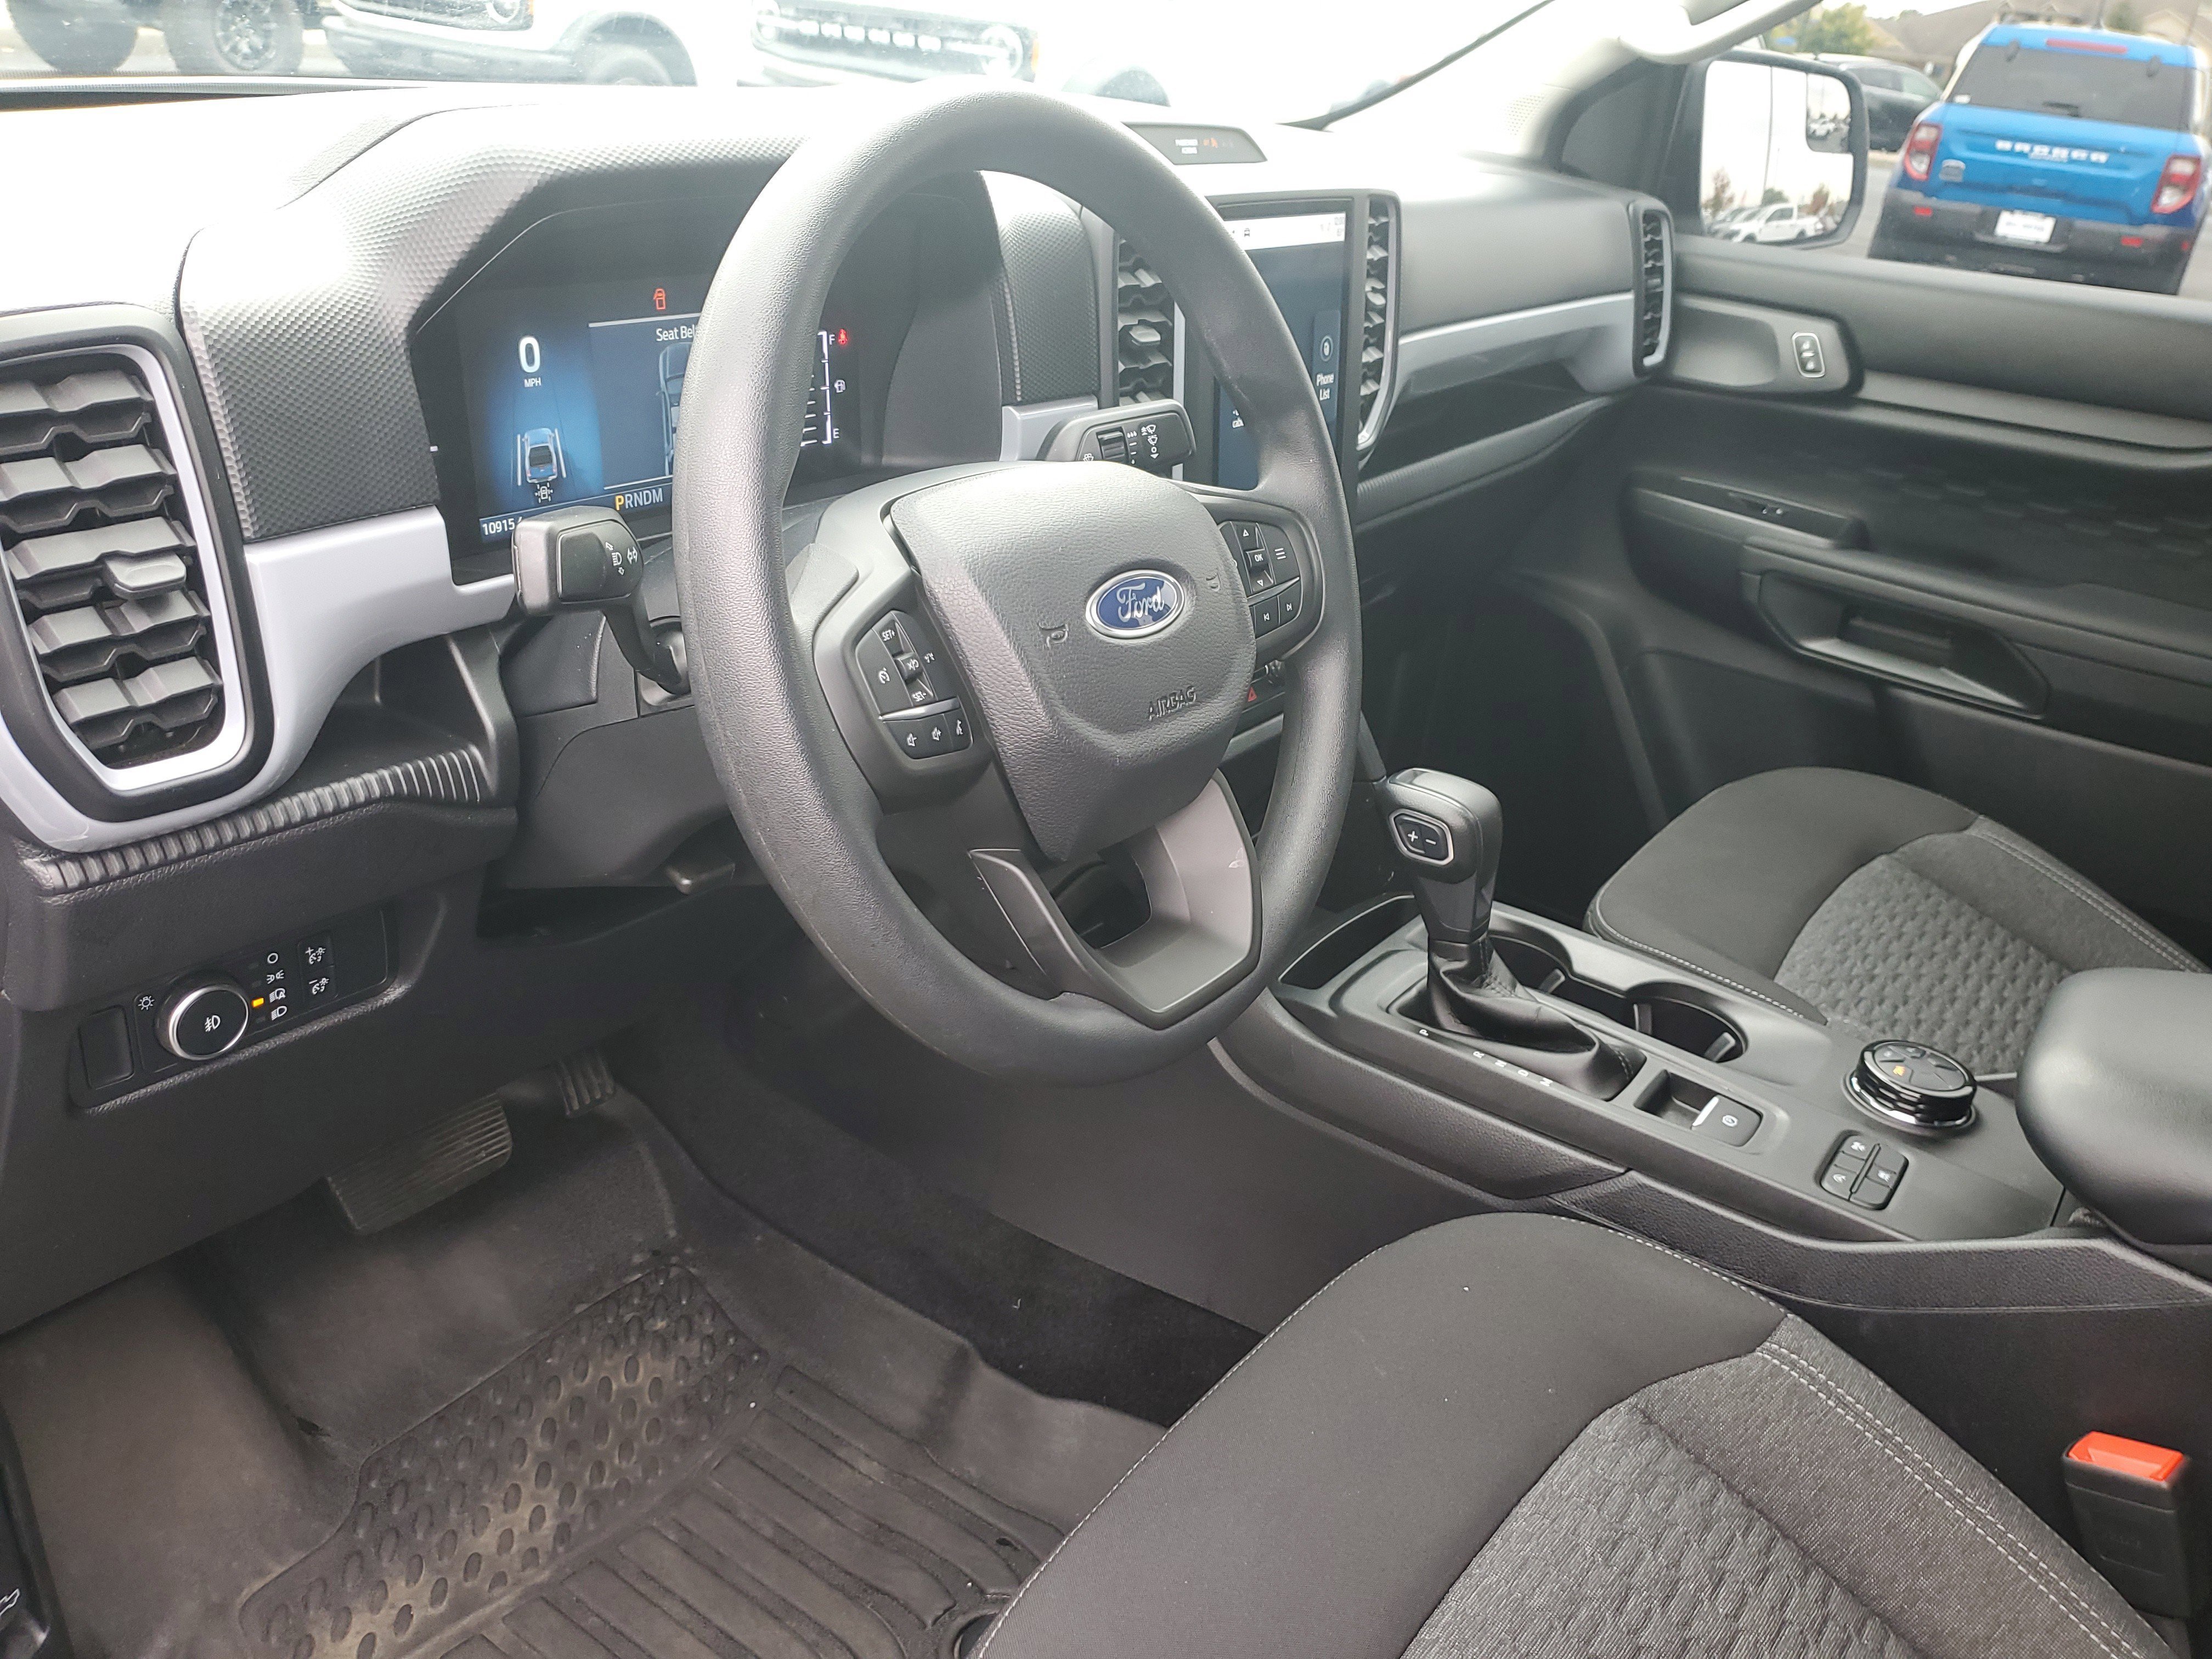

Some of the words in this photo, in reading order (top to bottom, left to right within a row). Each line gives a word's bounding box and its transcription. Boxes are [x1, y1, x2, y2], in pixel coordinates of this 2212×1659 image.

[656, 327, 679, 342] Seat
[680, 324, 695, 339] Bel
[829, 334, 836, 345] F
[518, 335, 540, 373] 0
[524, 376, 541, 388] MPH
[1316, 373, 1334, 386] Phone
[1319, 387, 1330, 400] List
[833, 428, 840, 439] E
[1254, 553, 1264, 562] OK
[1116, 582, 1165, 623] Ford
[1148, 685, 1197, 721] AIRBAG
[1419, 1028, 1429, 1036] P
[1472, 1050, 1485, 1059] R
[1494, 1059, 1508, 1068] N
[1517, 1069, 1529, 1077] D
[1539, 1077, 1553, 1087] M
